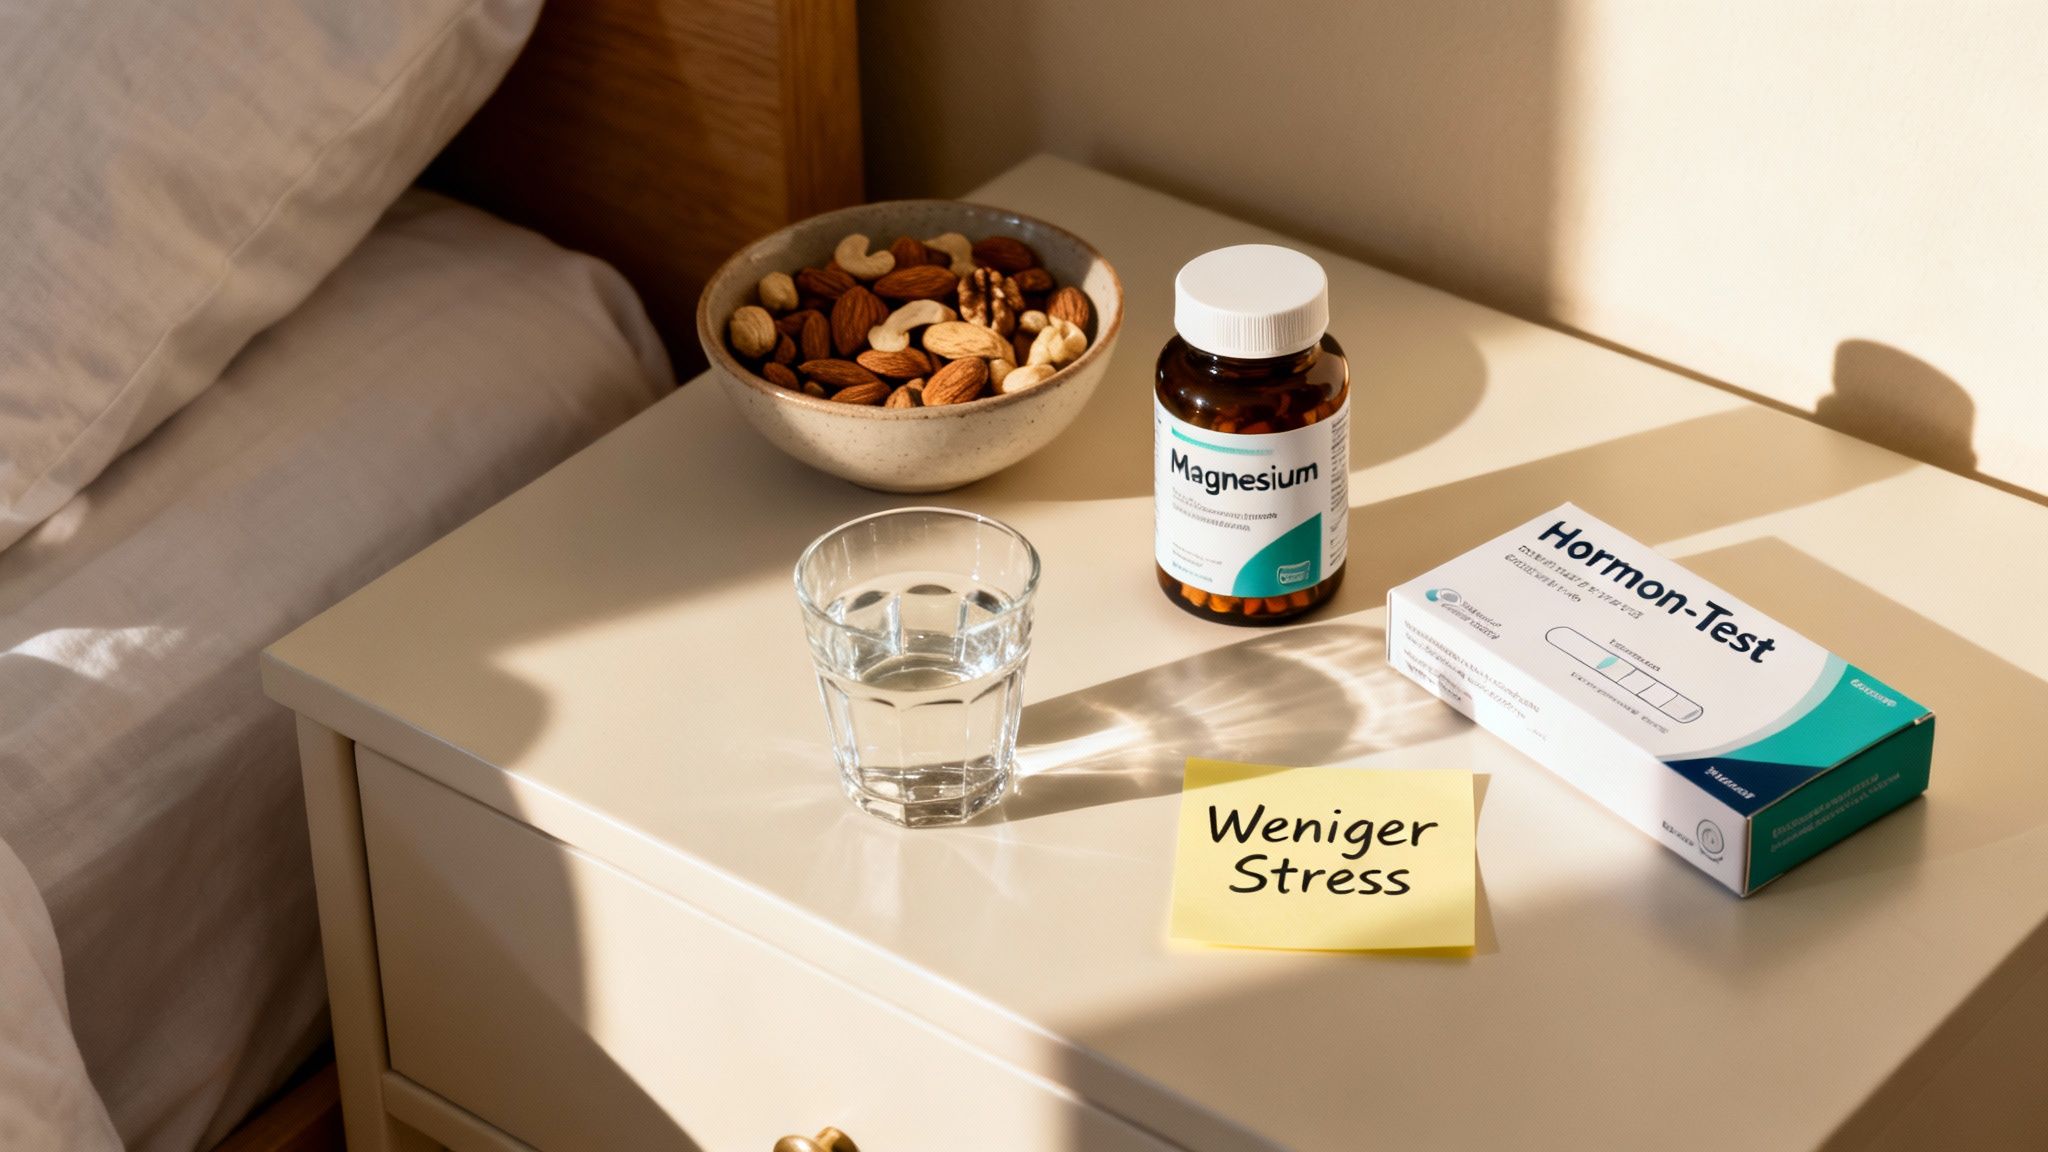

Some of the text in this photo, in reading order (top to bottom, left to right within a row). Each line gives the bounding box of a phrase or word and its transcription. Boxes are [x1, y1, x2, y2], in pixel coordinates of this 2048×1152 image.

[1171, 448, 1319, 496] Magnesium
[1537, 520, 1776, 664] Hormon-Test
[1209, 804, 1439, 860] Weniger
[1229, 853, 1411, 896] Stress
